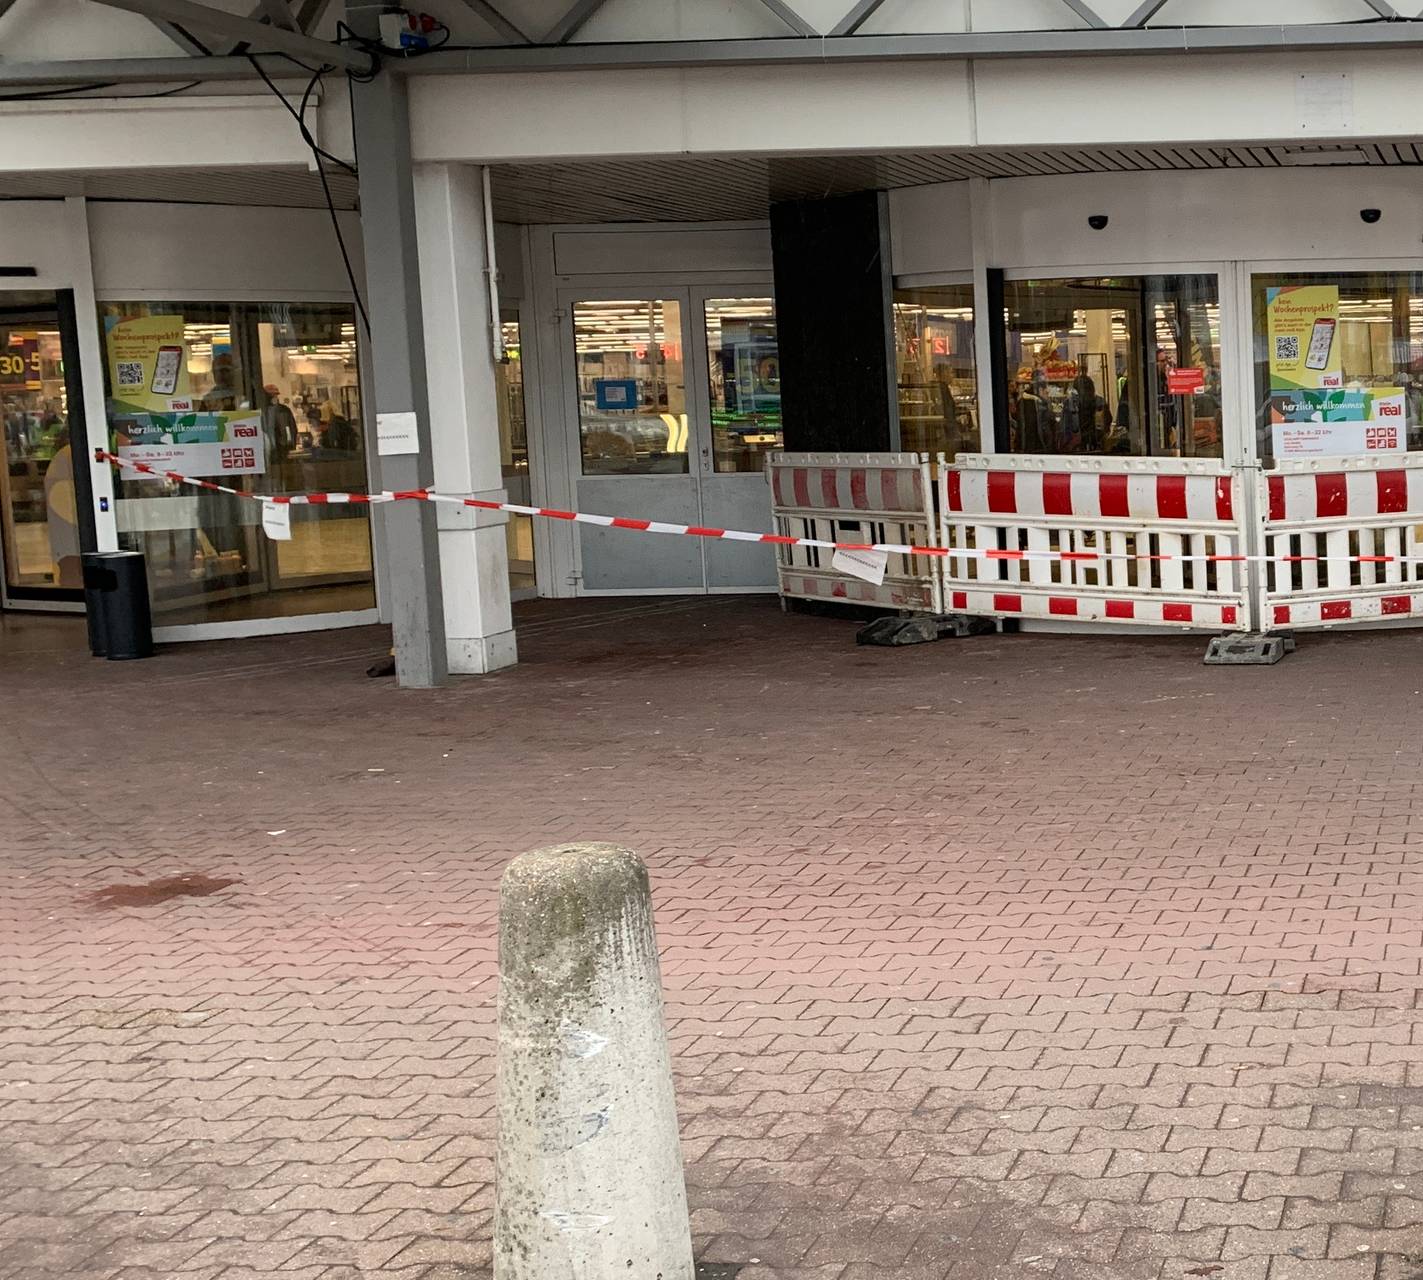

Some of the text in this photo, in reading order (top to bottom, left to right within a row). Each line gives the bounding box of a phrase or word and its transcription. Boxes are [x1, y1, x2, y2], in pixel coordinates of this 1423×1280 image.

[1273, 303, 1334, 316] Wochenprospekt?
[1323, 377, 1339, 386] real
[172, 401, 189, 410] real
[1282, 401, 1366, 411] herzlich willkommen
[1379, 404, 1401, 417] real
[128, 424, 218, 434] herzlich willkommen
[234, 426, 257, 438] real
